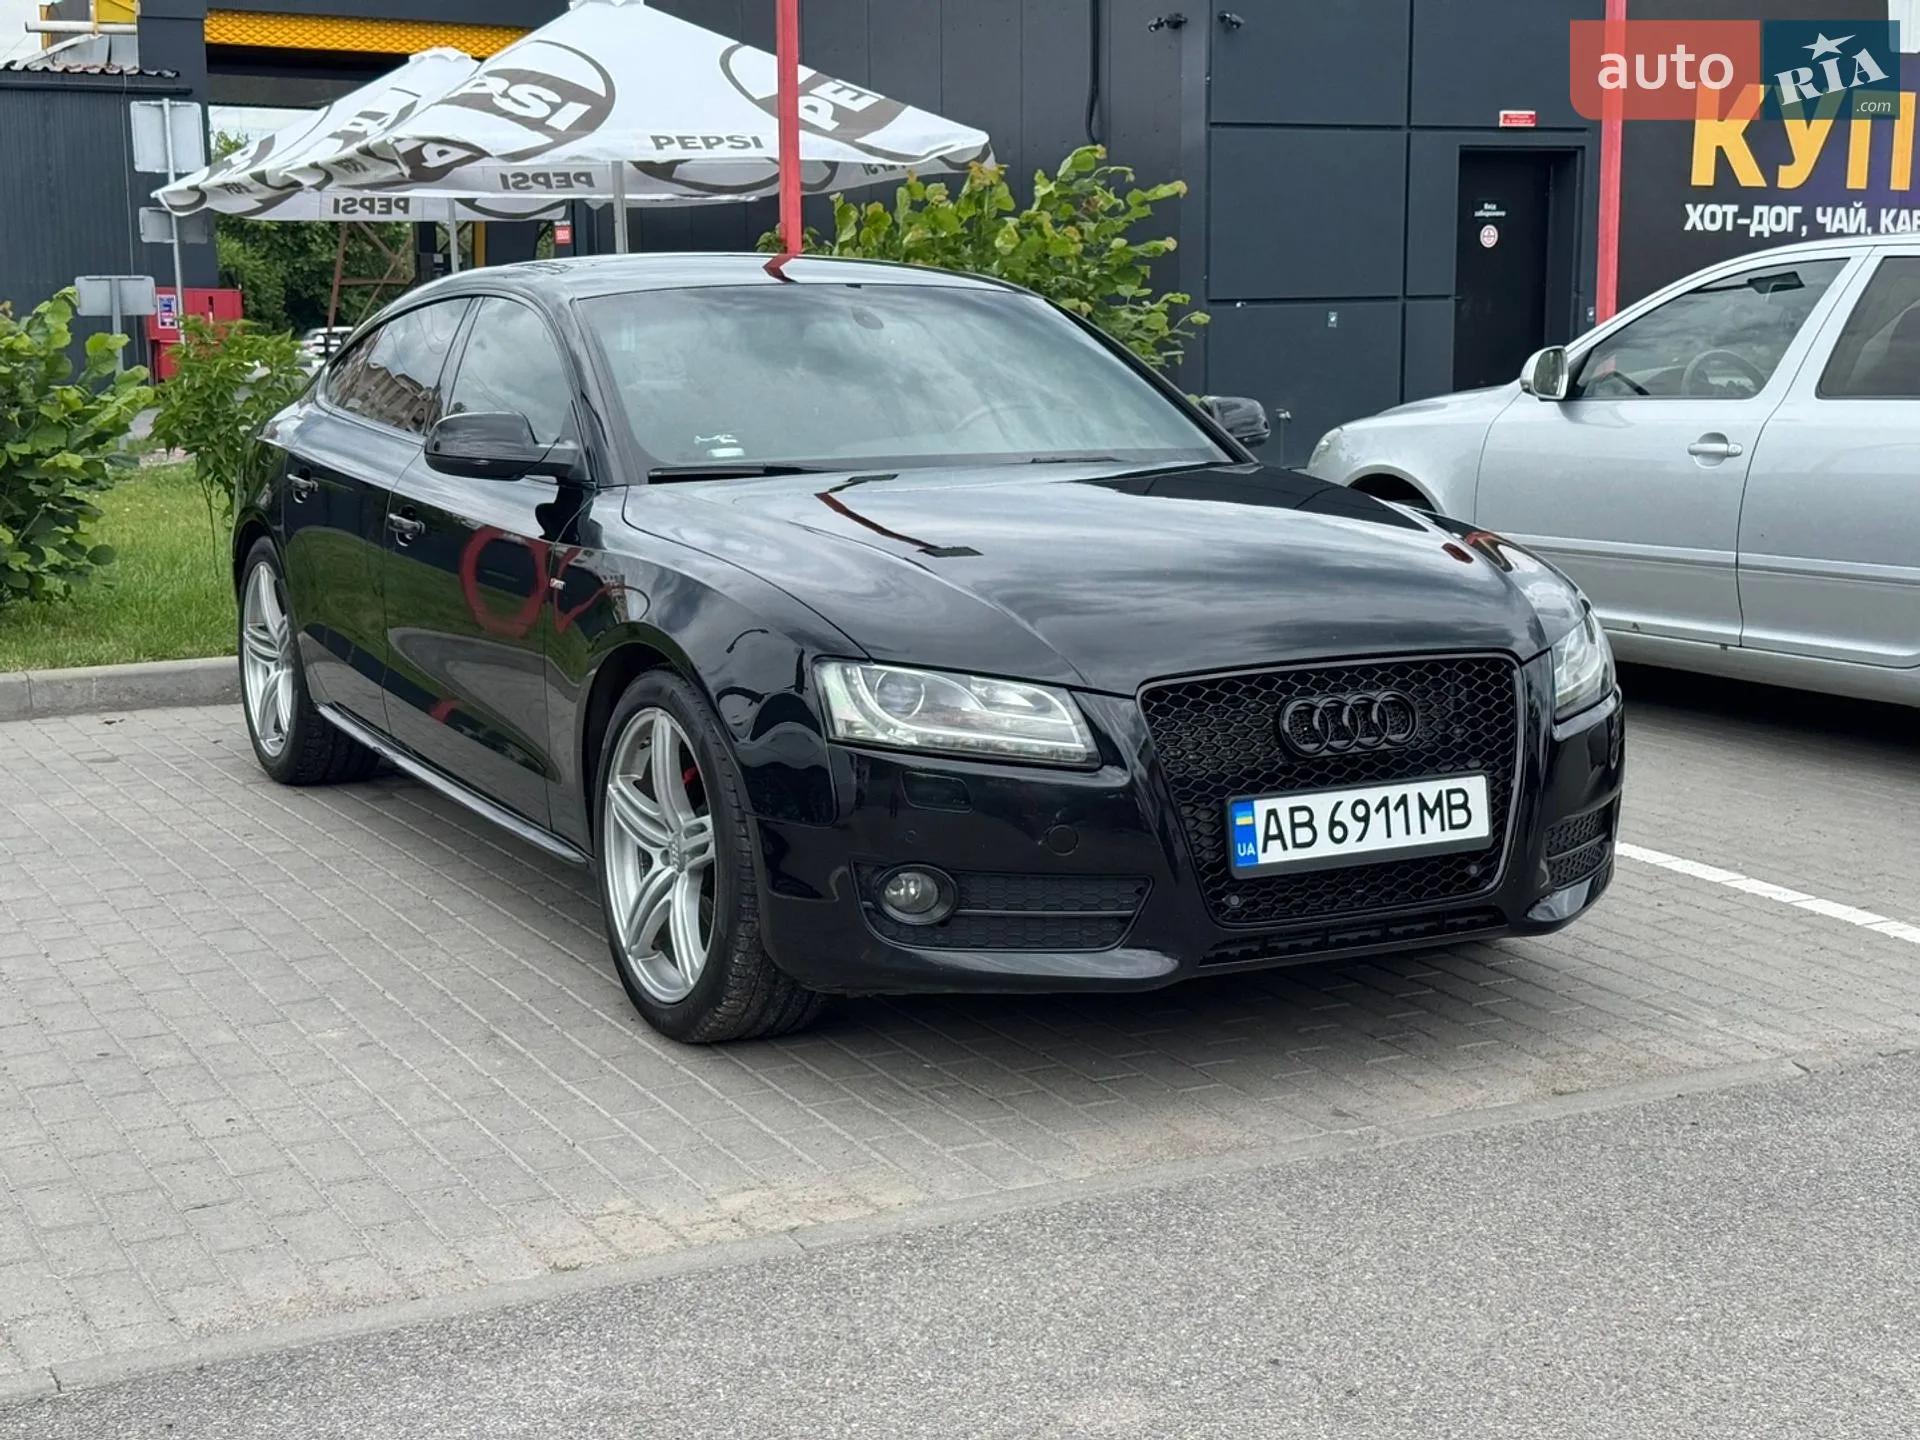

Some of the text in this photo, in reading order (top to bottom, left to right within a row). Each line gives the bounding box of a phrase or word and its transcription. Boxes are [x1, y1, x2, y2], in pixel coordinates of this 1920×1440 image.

[650, 135, 764, 151] PEPSI
[1684, 203, 1808, 237] ХОТ-ДОГ,
[1816, 201, 1872, 235] ЧАЙ,
[1261, 787, 1473, 854] AB 6911 MB
[1237, 842, 1256, 857] UA
